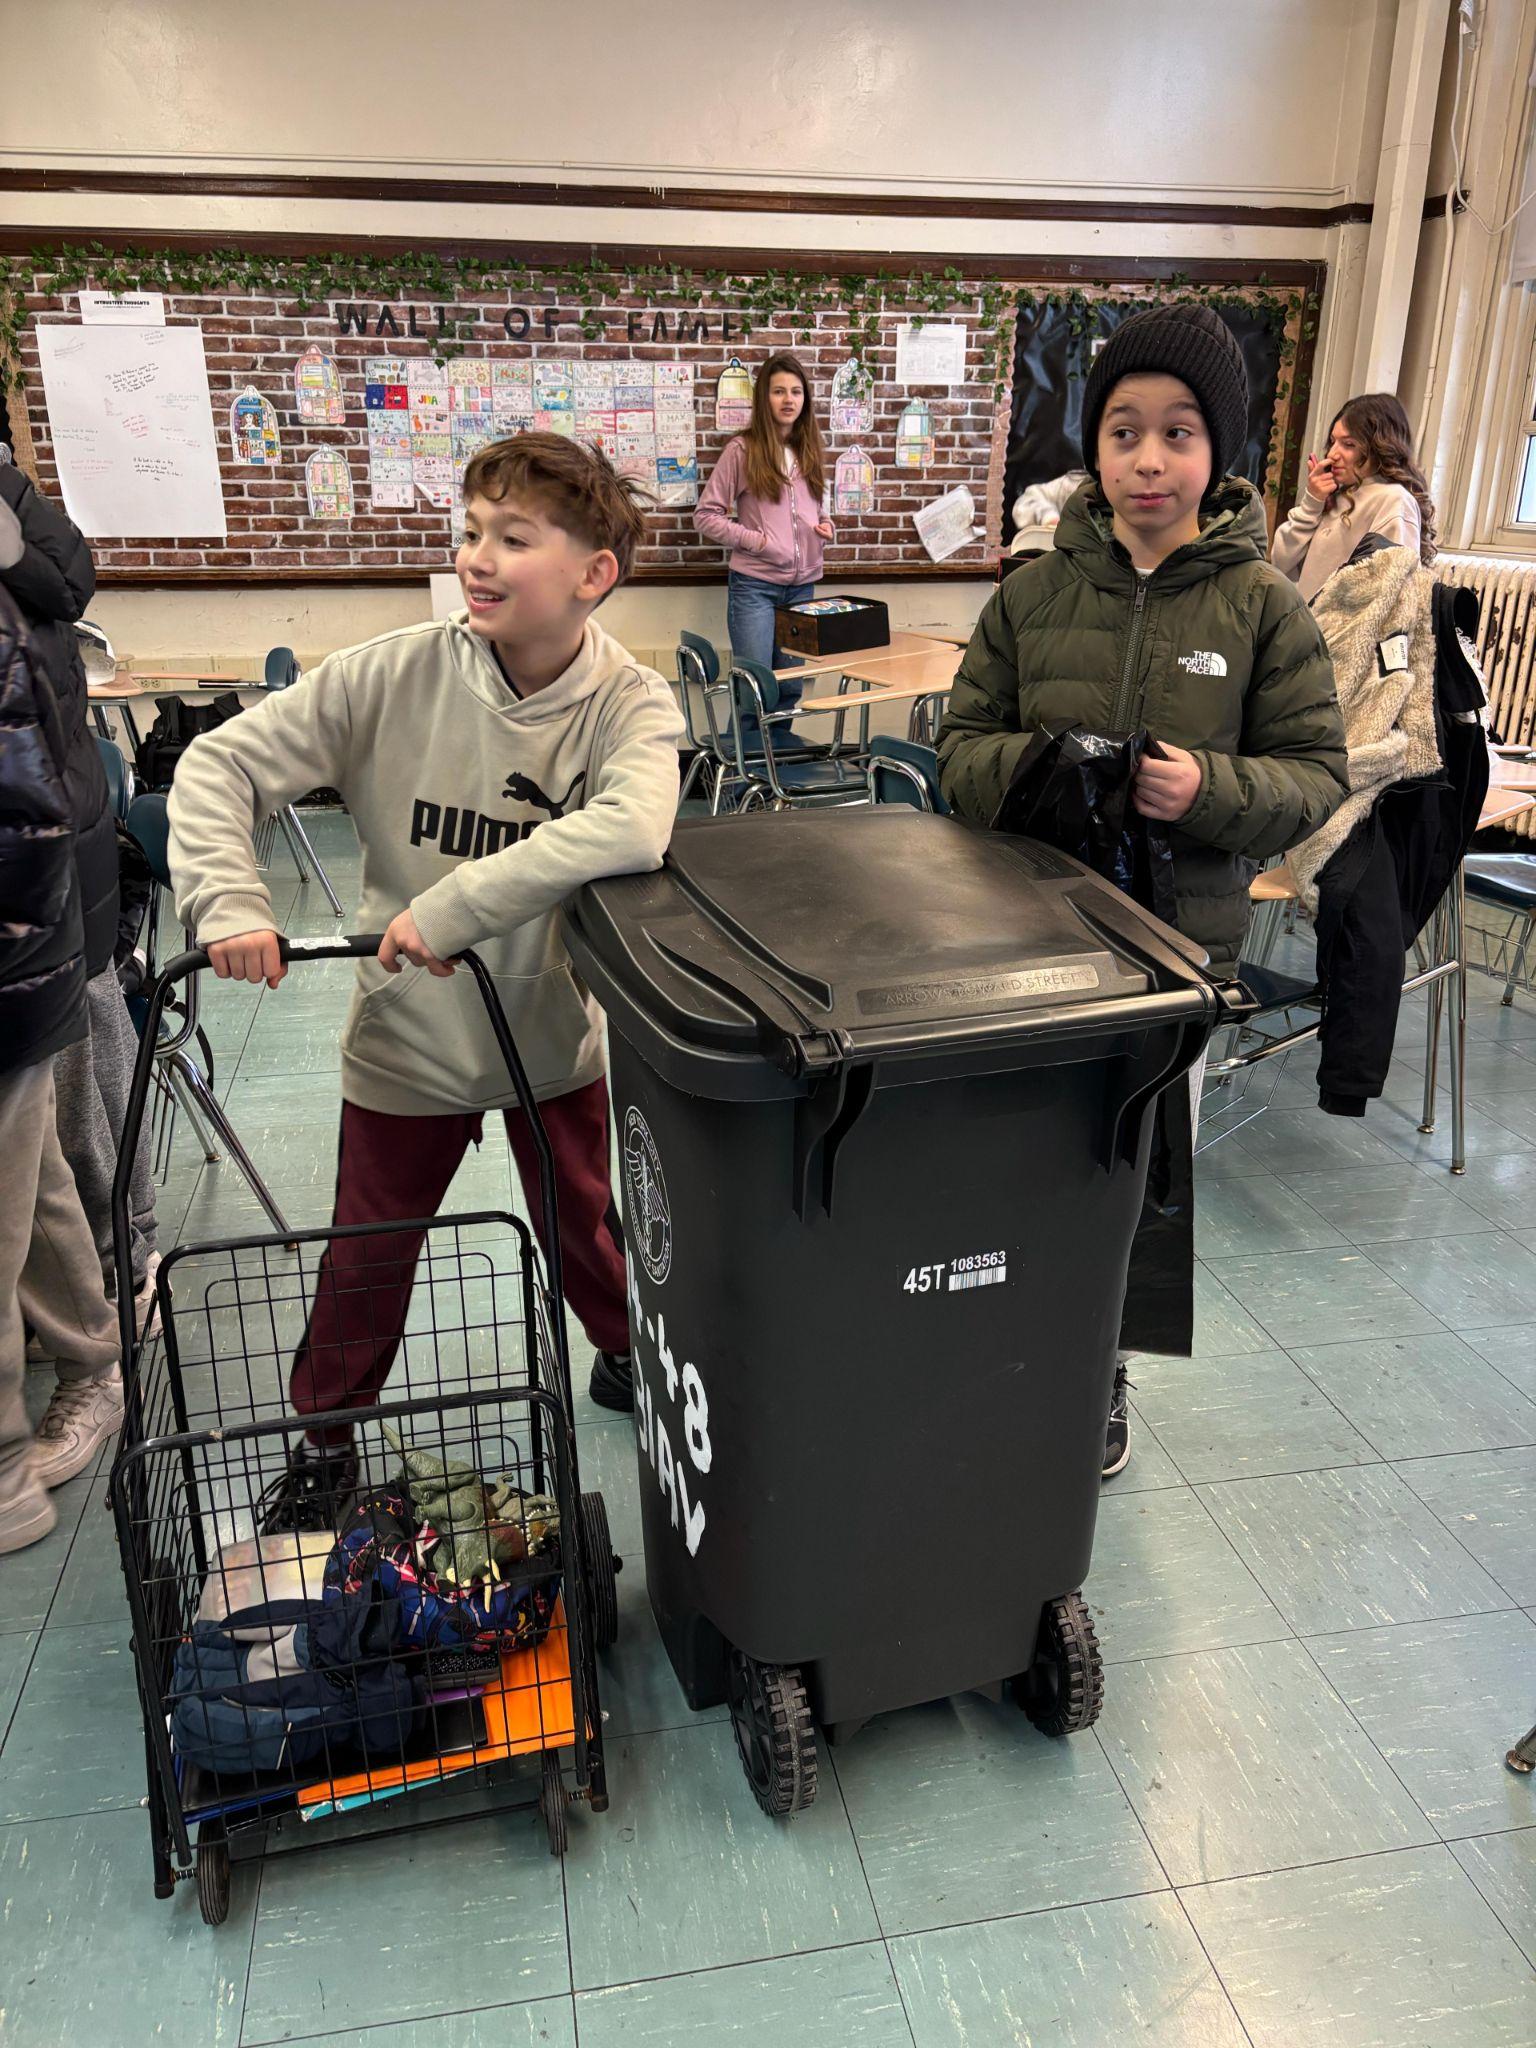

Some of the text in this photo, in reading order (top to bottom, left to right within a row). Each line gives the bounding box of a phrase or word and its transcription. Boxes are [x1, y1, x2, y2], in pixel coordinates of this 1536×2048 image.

[503, 308, 560, 338] OF
[627, 311, 738, 342] FAME
[1178, 656, 1211, 668] NORTH
[1193, 650, 1212, 660] THE
[1186, 665, 1210, 675] FACE
[1027, 971, 1077, 990] STREET
[648, 1139, 661, 1171] CITY
[903, 1250, 1007, 1294] 45T 1083563
